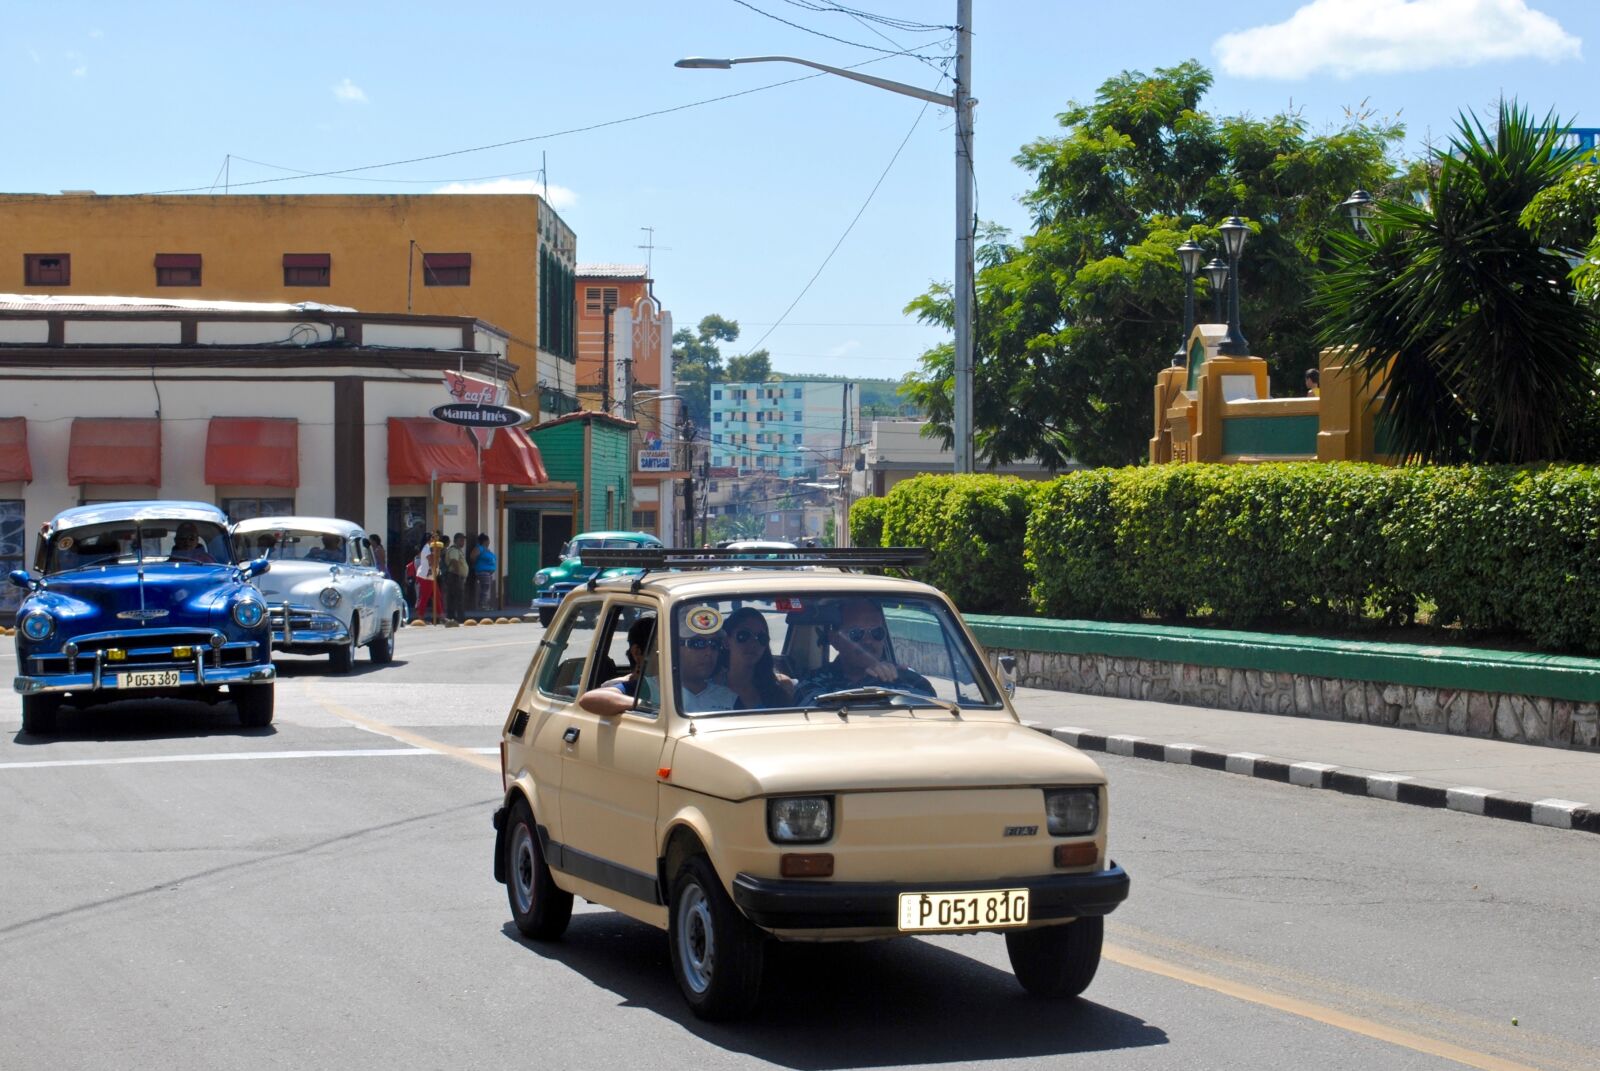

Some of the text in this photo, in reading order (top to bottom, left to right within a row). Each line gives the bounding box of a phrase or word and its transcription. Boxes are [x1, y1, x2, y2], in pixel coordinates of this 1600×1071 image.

[464, 387, 493, 409] café
[442, 408, 507, 422] Mama Inés
[126, 675, 133, 686] P
[135, 674, 156, 686] 053
[158, 674, 178, 685] 389
[919, 895, 1026, 926] P 051 810
